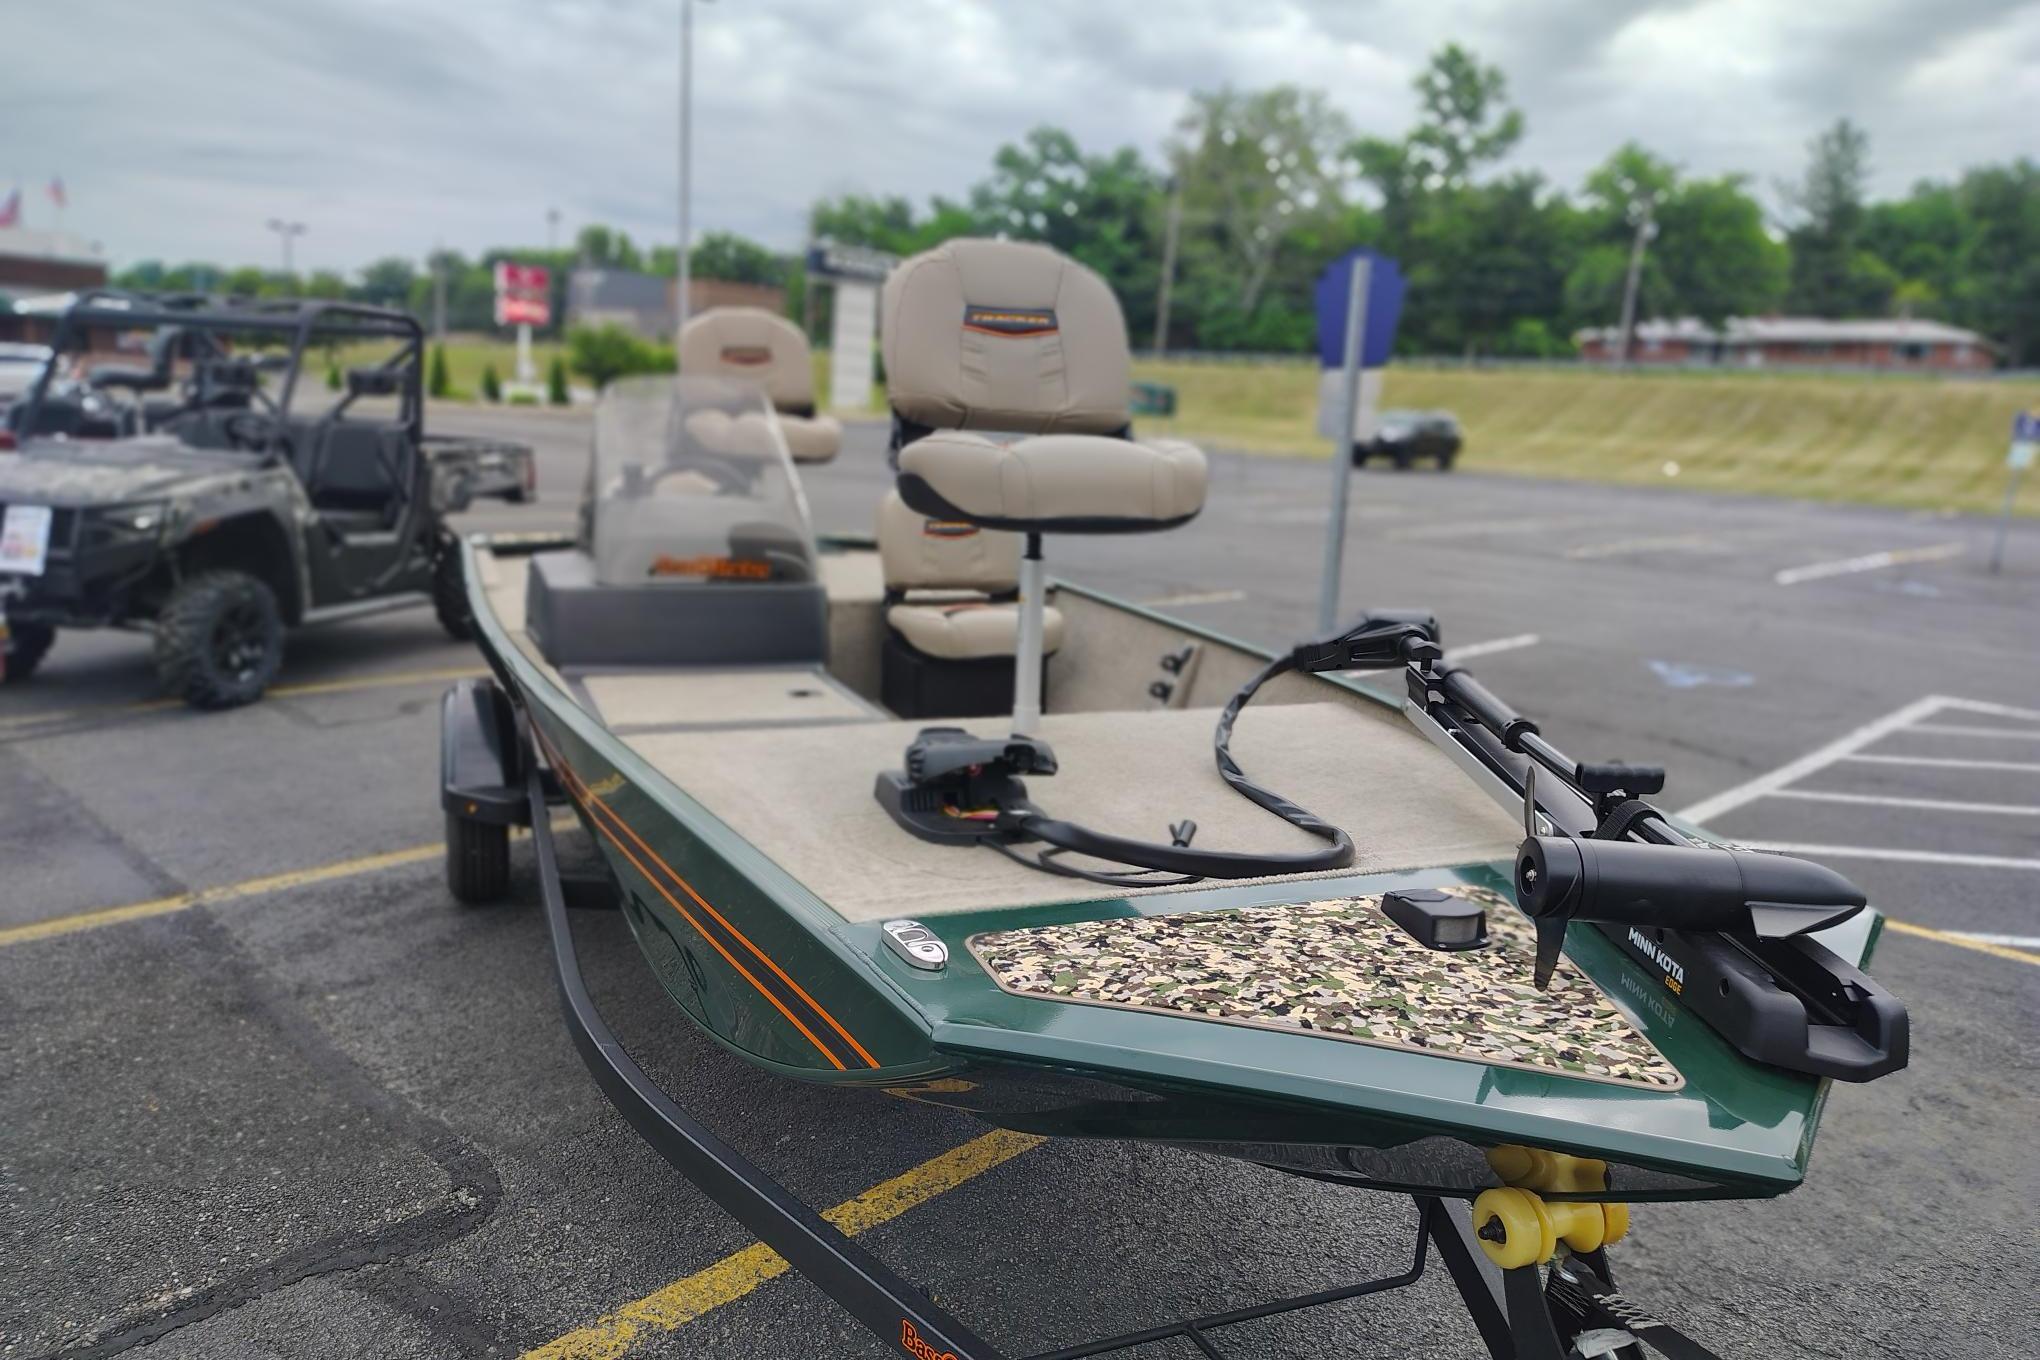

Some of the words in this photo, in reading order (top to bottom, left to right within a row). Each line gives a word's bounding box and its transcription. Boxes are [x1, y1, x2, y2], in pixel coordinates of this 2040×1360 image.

[971, 311, 1050, 324] TRACKER
[1628, 926, 1657, 960] MINN
[1656, 949, 1685, 985] KOTA
[1664, 975, 1683, 996] EDGE
